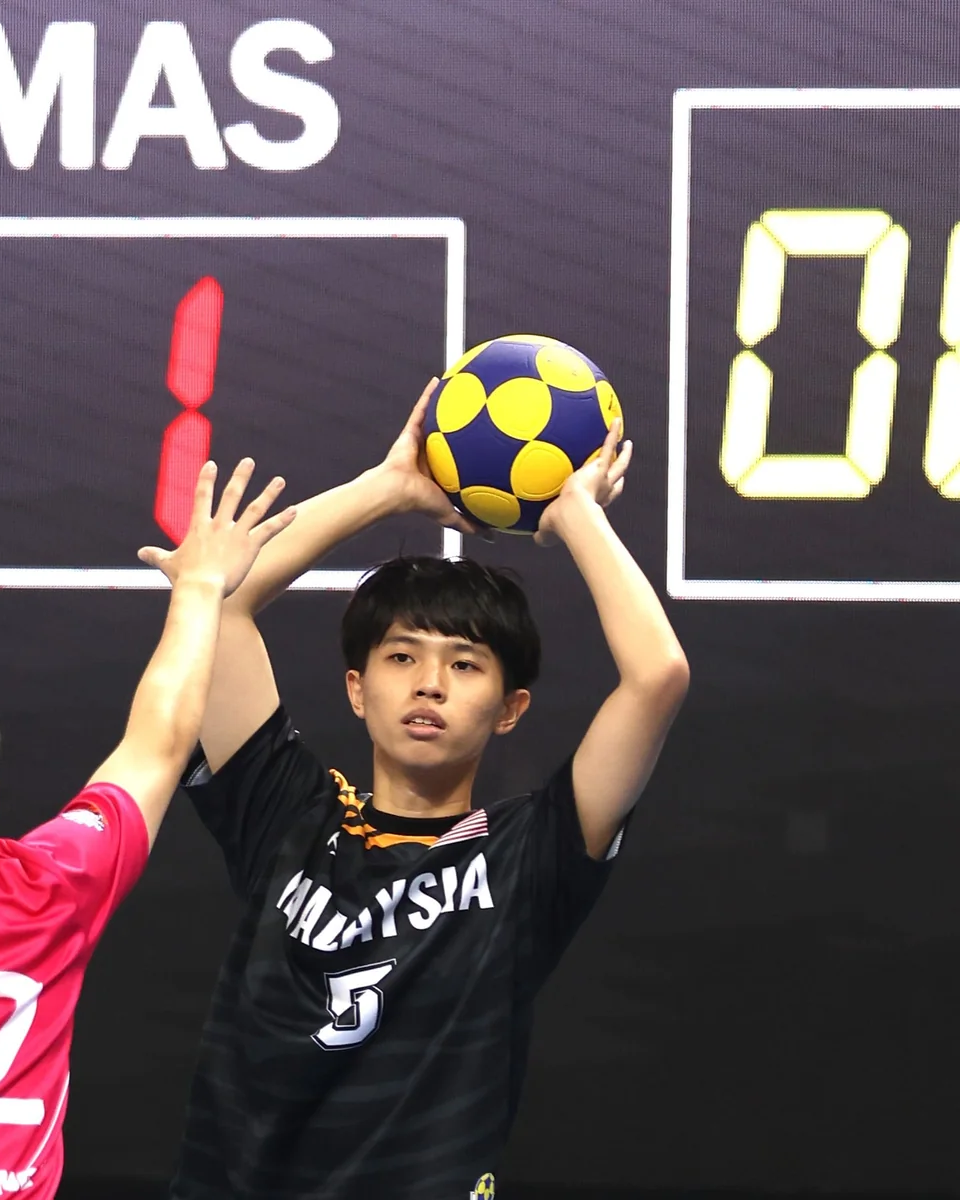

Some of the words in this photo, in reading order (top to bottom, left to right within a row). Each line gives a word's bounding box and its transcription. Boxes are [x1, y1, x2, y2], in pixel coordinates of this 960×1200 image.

[153, 276, 224, 545] 1
[719, 208, 960, 499] 0
[276, 852, 495, 952] MALAYSIA
[310, 958, 397, 1052] 5
